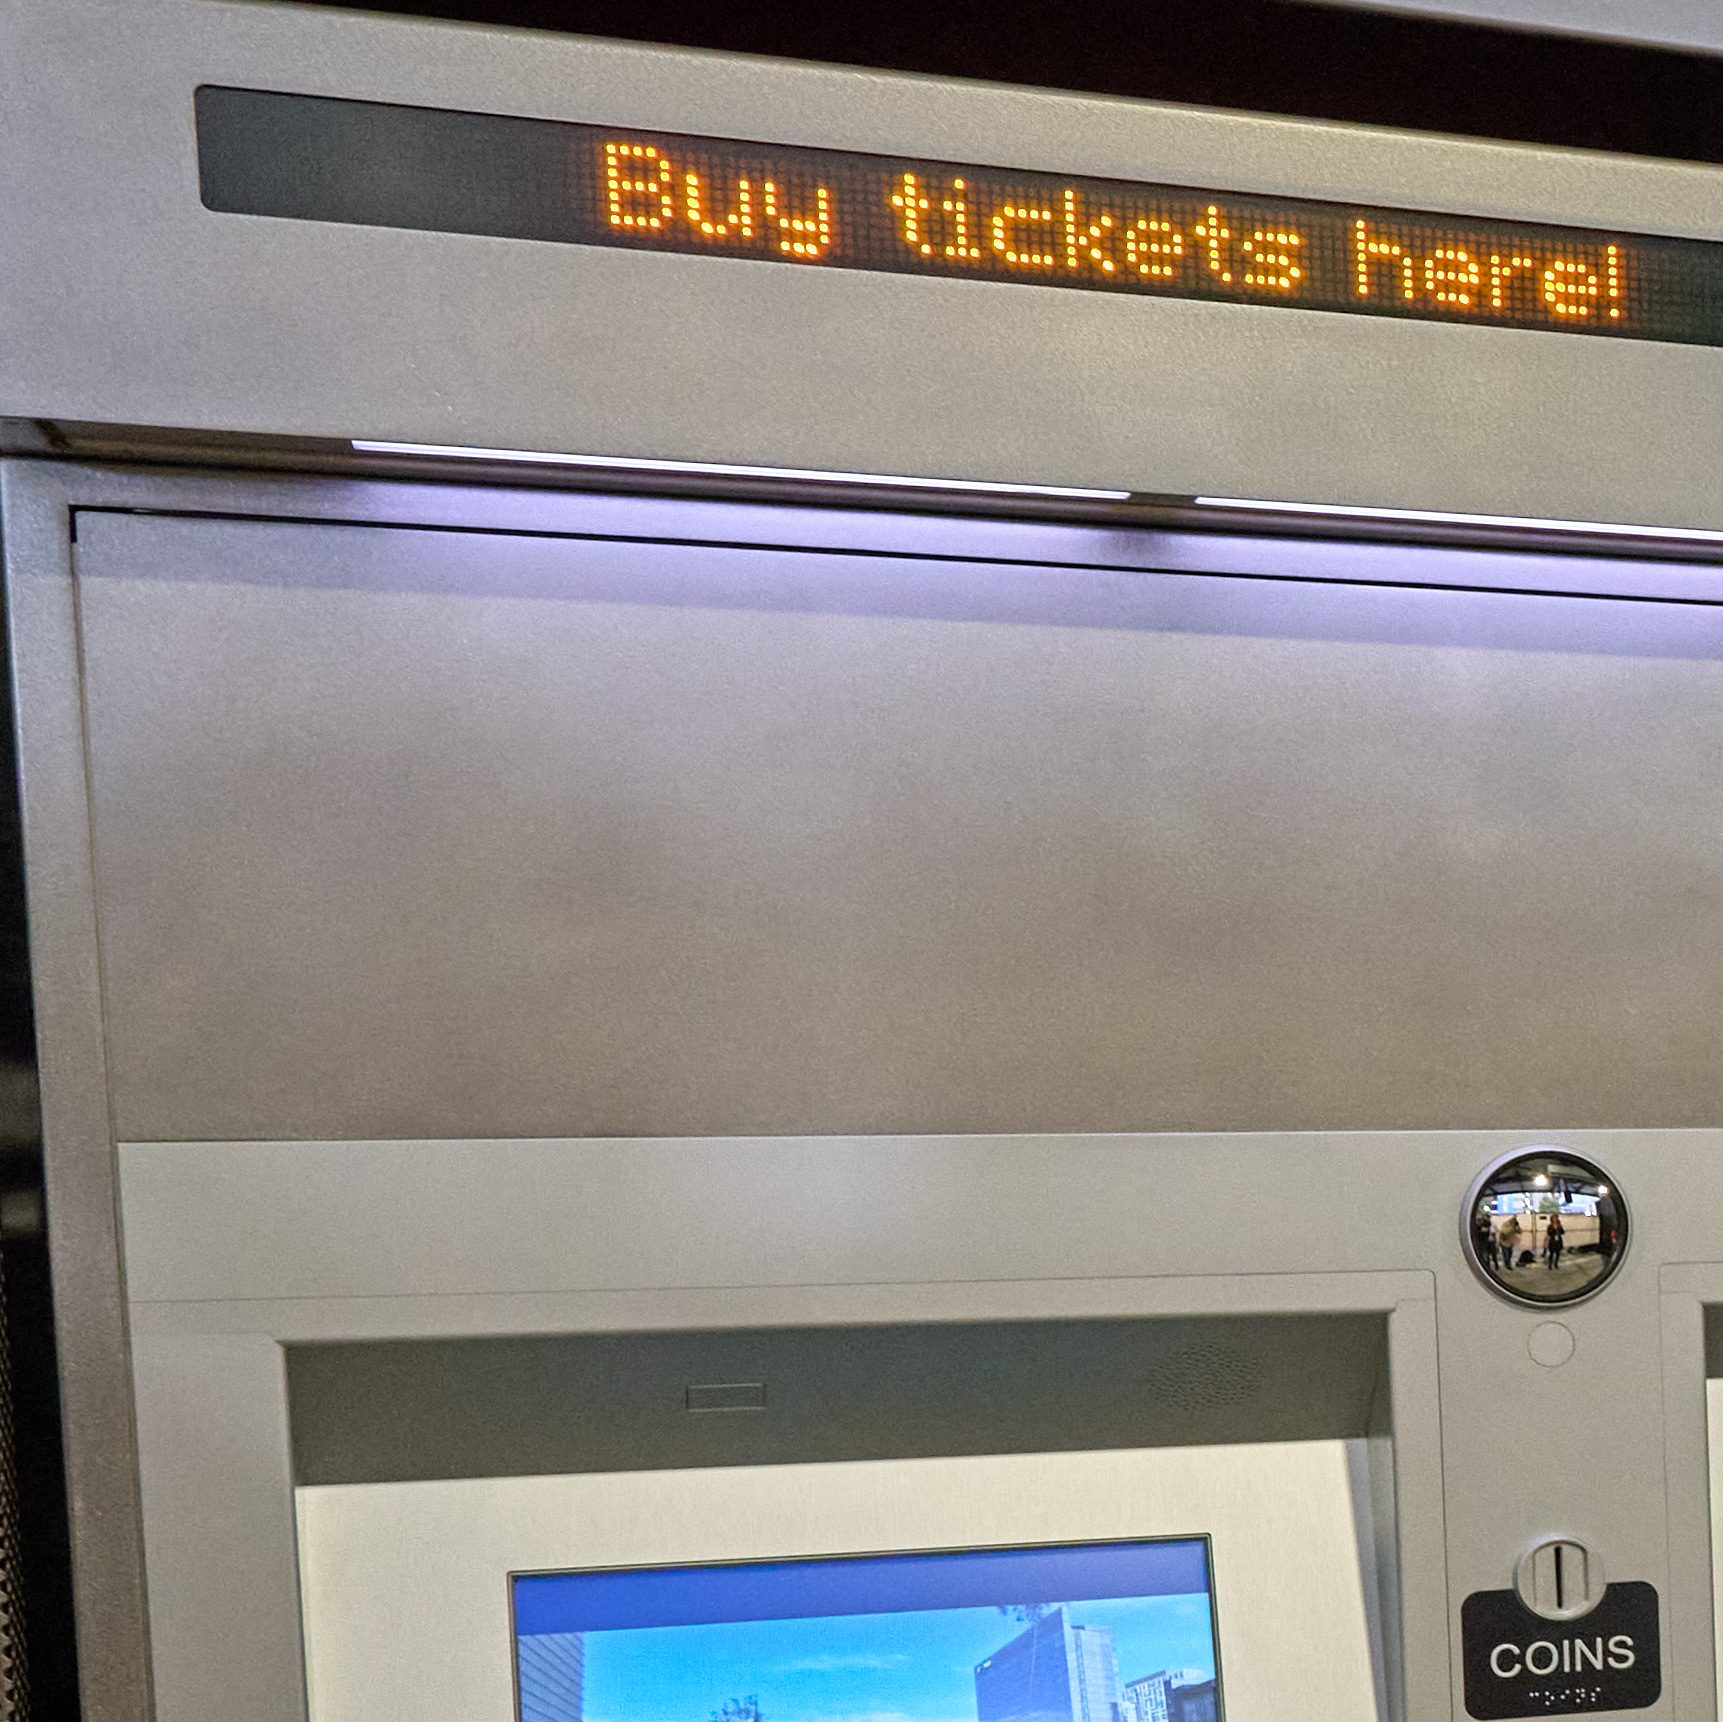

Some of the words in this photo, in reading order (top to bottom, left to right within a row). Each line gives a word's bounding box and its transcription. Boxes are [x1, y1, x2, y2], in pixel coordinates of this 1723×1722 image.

[604, 142, 832, 258] Buy
[892, 172, 1303, 290] tickets
[1354, 219, 1621, 320] here!
[1489, 1635, 1636, 1679] COINS
